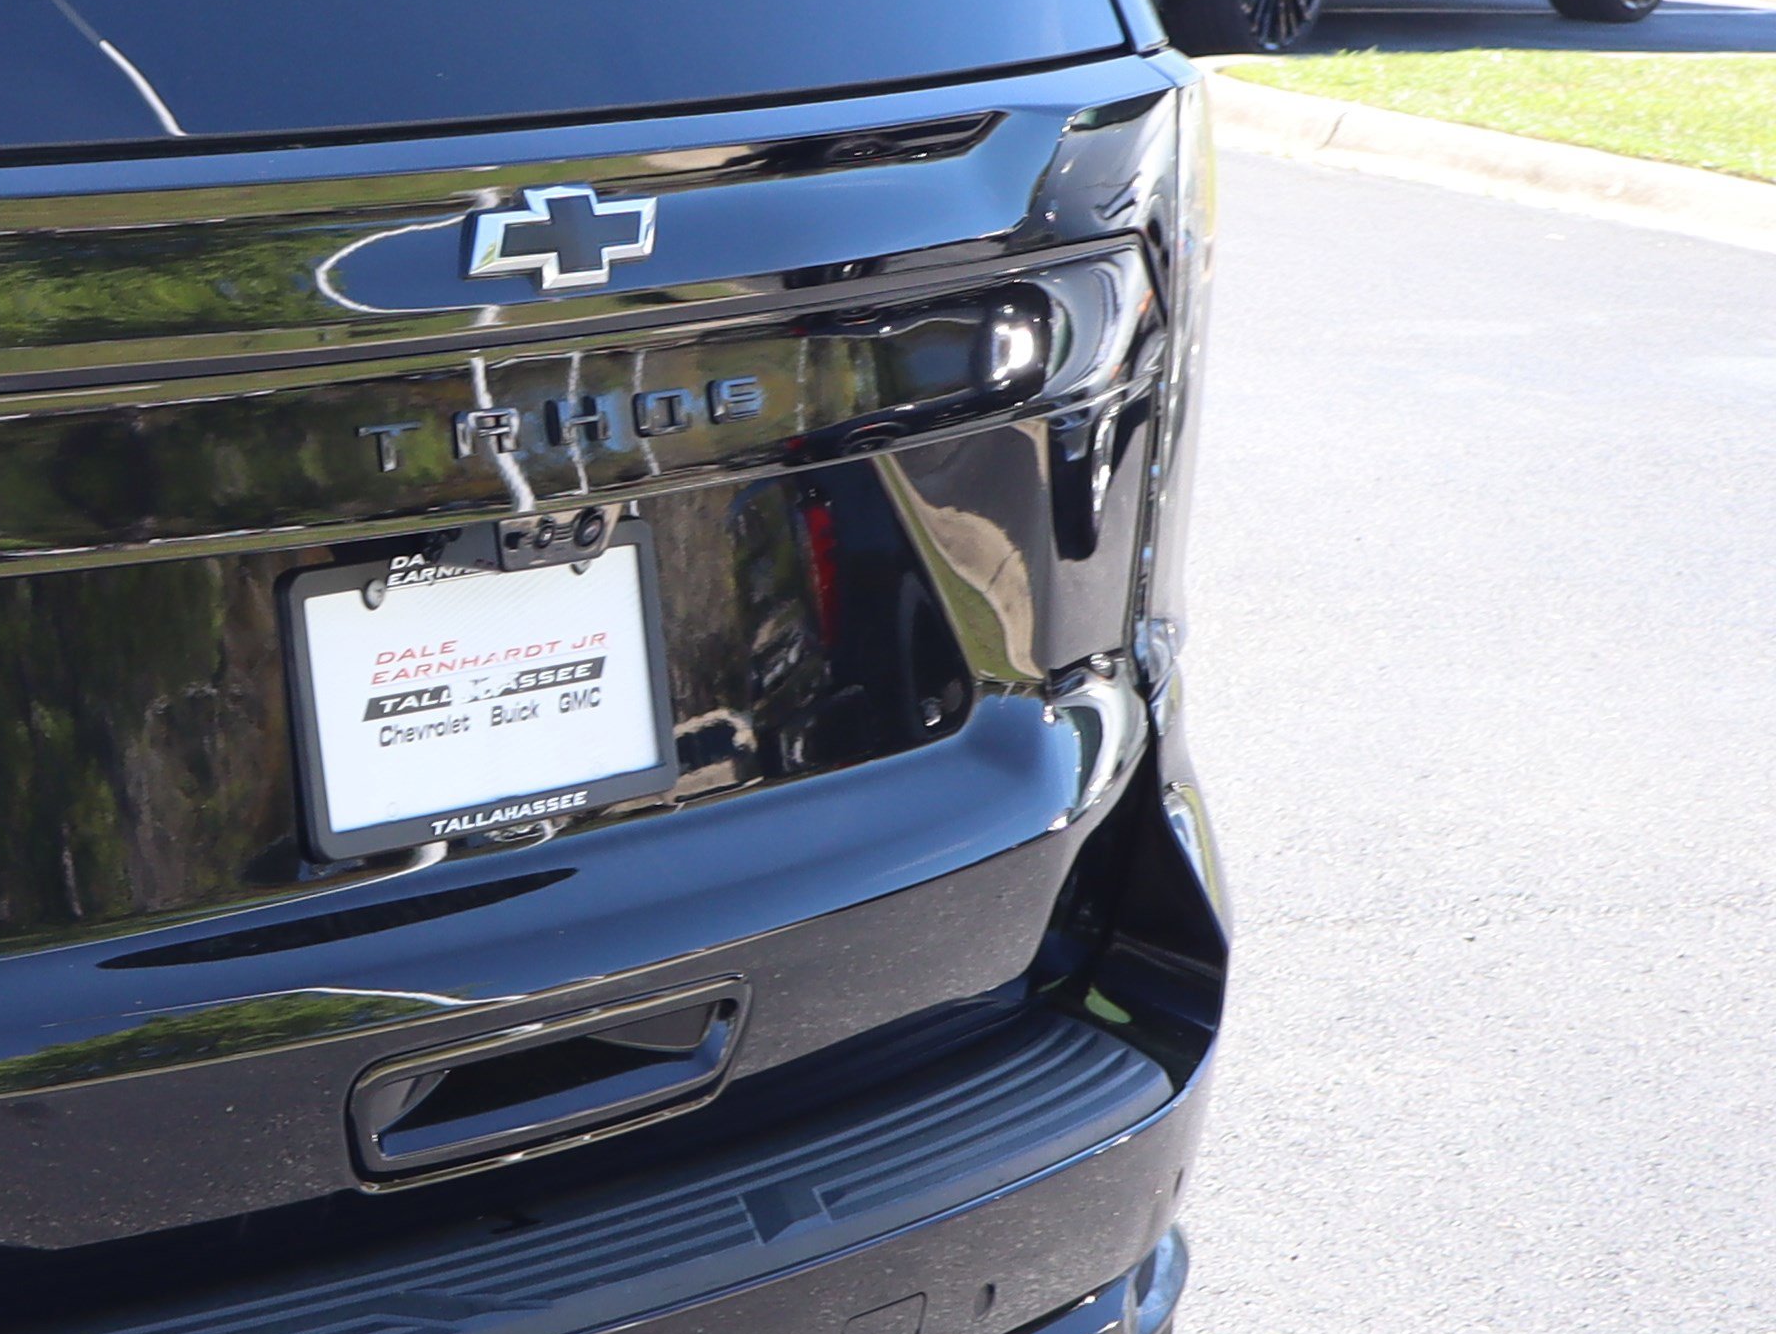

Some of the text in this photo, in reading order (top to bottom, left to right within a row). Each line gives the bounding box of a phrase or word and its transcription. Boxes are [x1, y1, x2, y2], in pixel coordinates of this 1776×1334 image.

[374, 640, 458, 666] DALE
[571, 632, 608, 650] JR
[378, 662, 594, 714] TALLASSEE
[379, 687, 602, 748] Chevrolet Buick GMC
[430, 790, 589, 836] TALLAHASSEE
